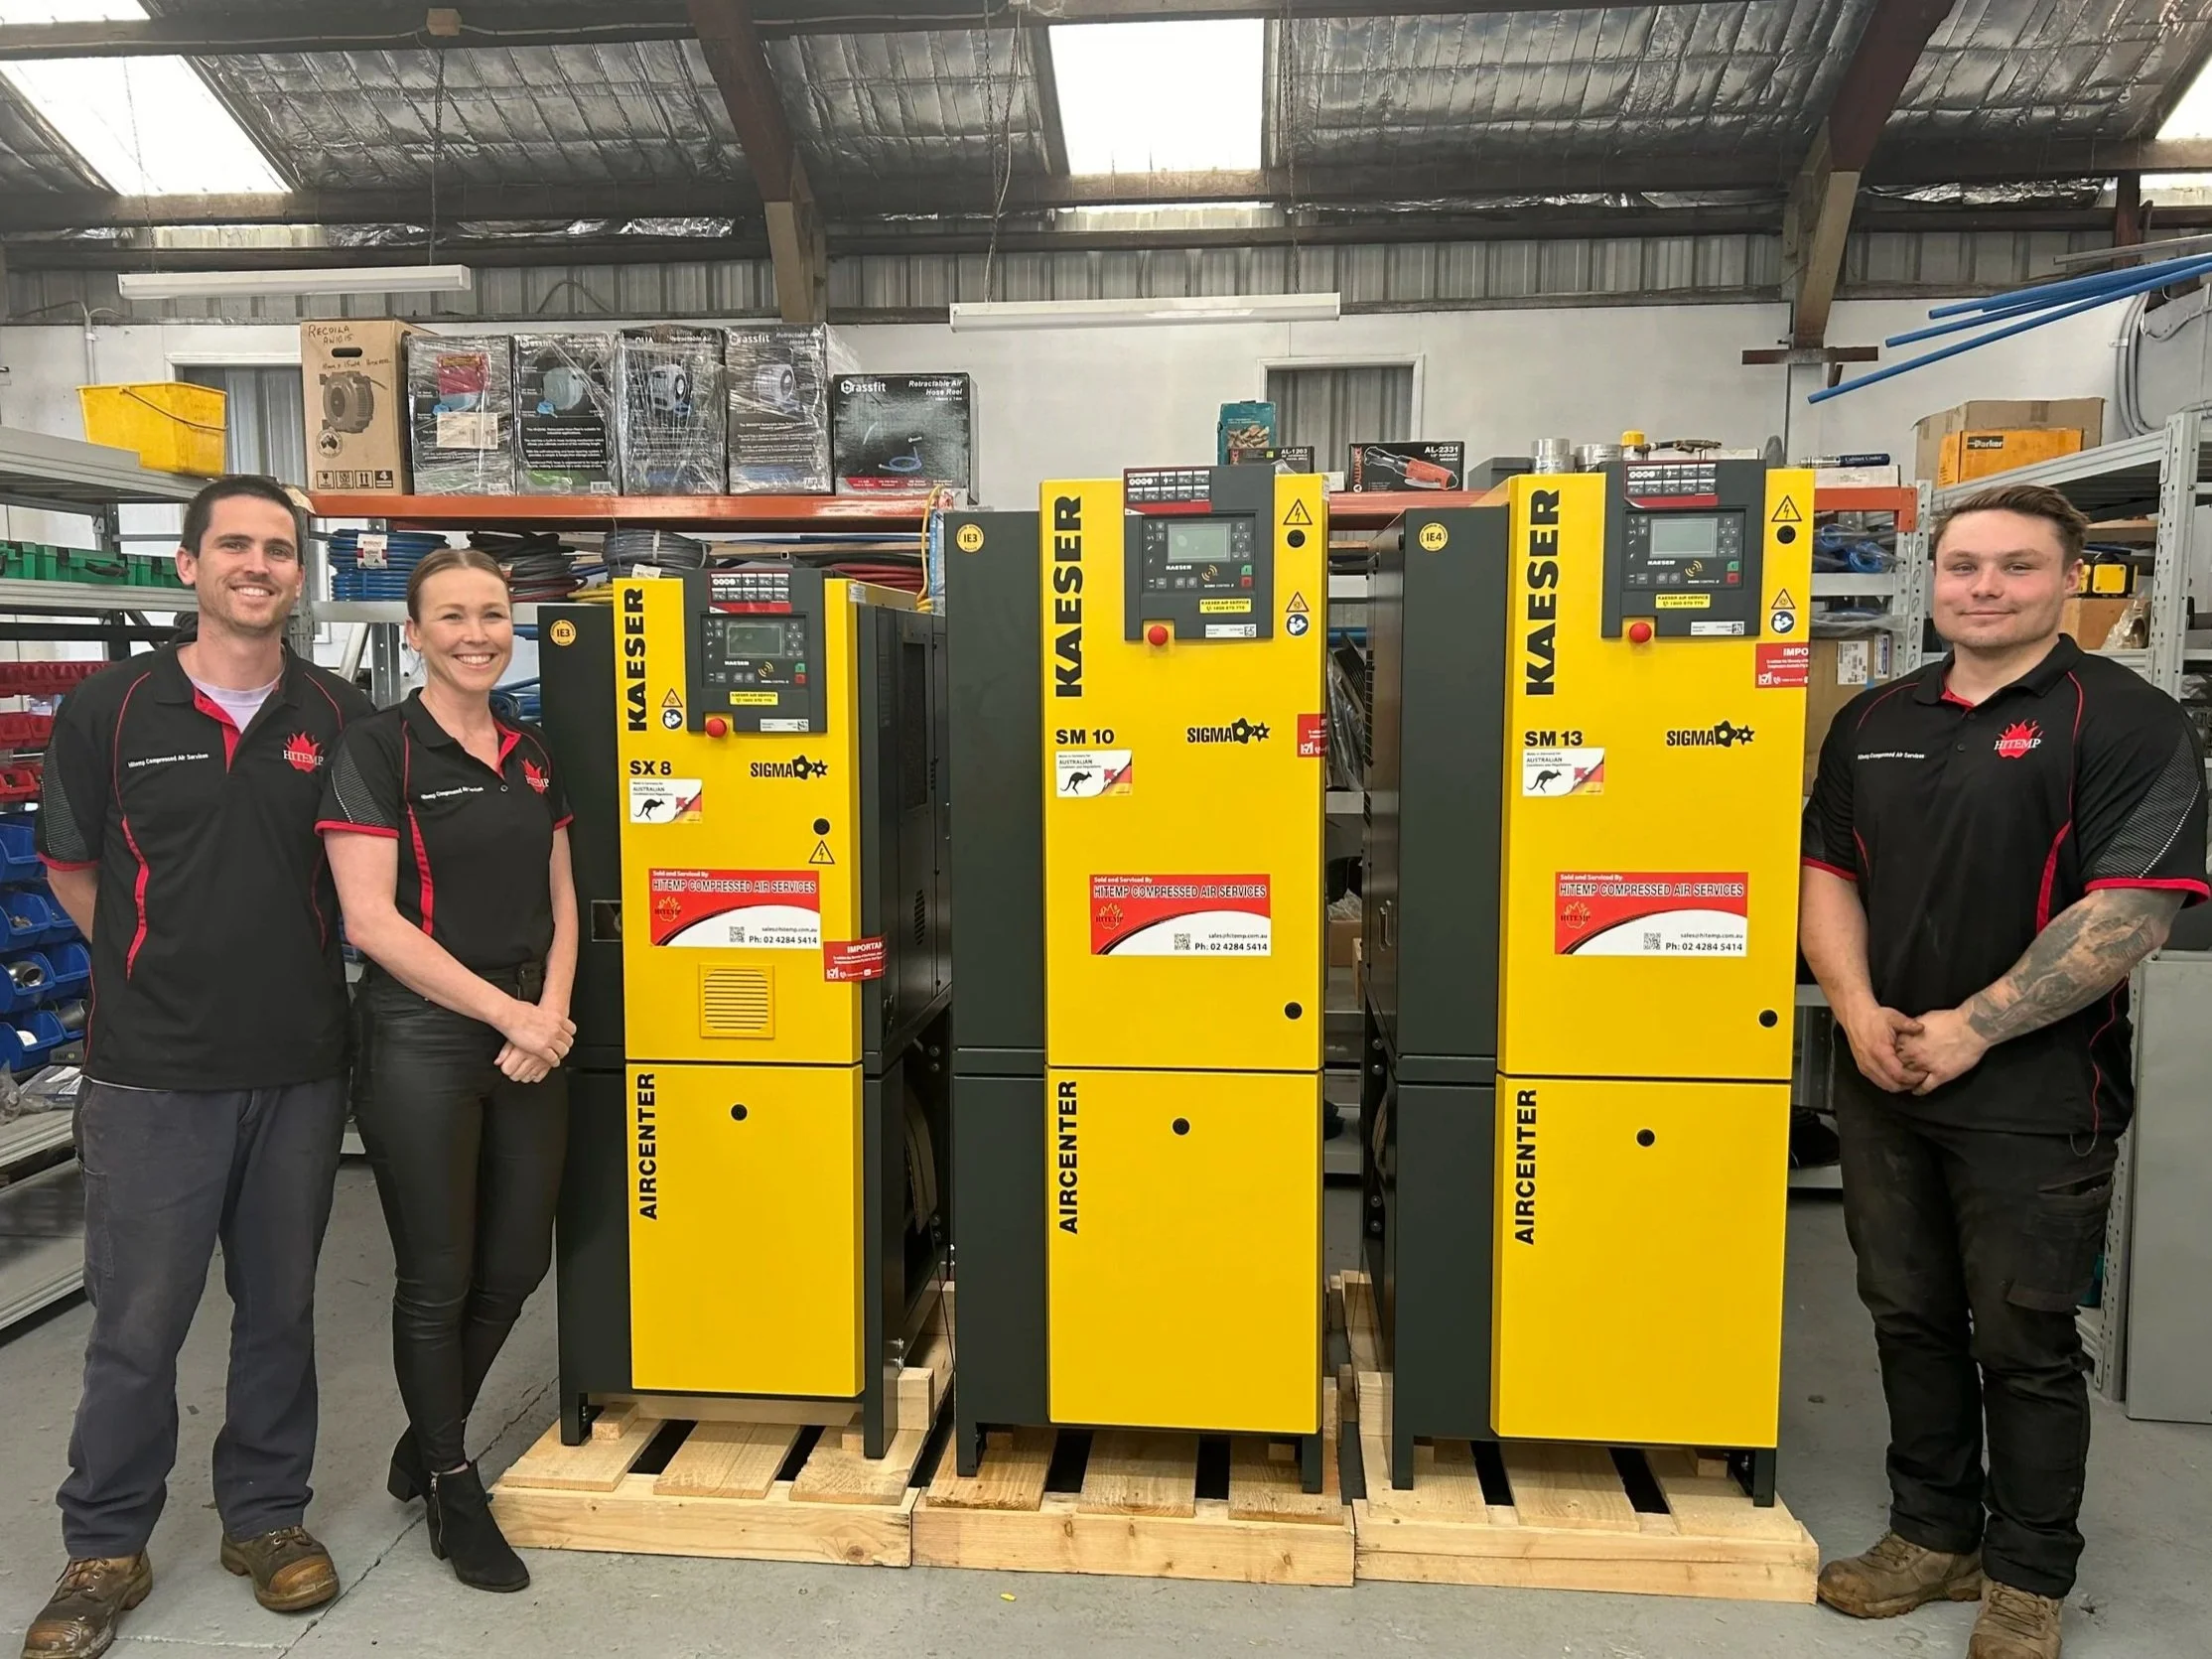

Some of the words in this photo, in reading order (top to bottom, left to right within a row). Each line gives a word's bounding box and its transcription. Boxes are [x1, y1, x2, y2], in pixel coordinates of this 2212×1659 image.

[1975, 439, 2003, 448] Parker
[963, 533, 978, 543] IE3
[1426, 532, 1443, 542] IE4
[1053, 495, 1083, 697] KAESER
[1526, 489, 1560, 695] KAESER
[623, 588, 647, 732] KAESER
[1055, 729, 1086, 745] SM
[1092, 729, 1115, 745] 10
[1187, 728, 1233, 744] SIGMA
[1524, 731, 1557, 747] SM
[1561, 731, 1584, 747] 13
[1666, 731, 1715, 746] SIGMA
[1994, 738, 2042, 751] HITEMP
[283, 750, 324, 765] HITEMP
[629, 760, 656, 775] SX
[660, 760, 672, 775] 8
[751, 762, 794, 778] SIGMA
[652, 879, 688, 892] HITEMP
[689, 880, 753, 893] COMPRESSED
[754, 880, 770, 893] AIR
[770, 881, 816, 894] SERVICES
[1094, 885, 1130, 899] HITEMP
[1131, 885, 1198, 899] COMPRESSED
[1199, 886, 1217, 899] AIR
[1218, 886, 1266, 899] SERVICES
[1560, 883, 1597, 897] HITEMP
[1599, 883, 1671, 897] COMPRESSED
[1673, 883, 1690, 897] AIR
[1693, 883, 1743, 897] SERVICES
[1721, 942, 1742, 951] 5414
[637, 1073, 657, 1220] AIRCENTER
[1058, 1081, 1078, 1234] AIRCENTER
[1514, 1090, 1537, 1245] AIRCENTER
